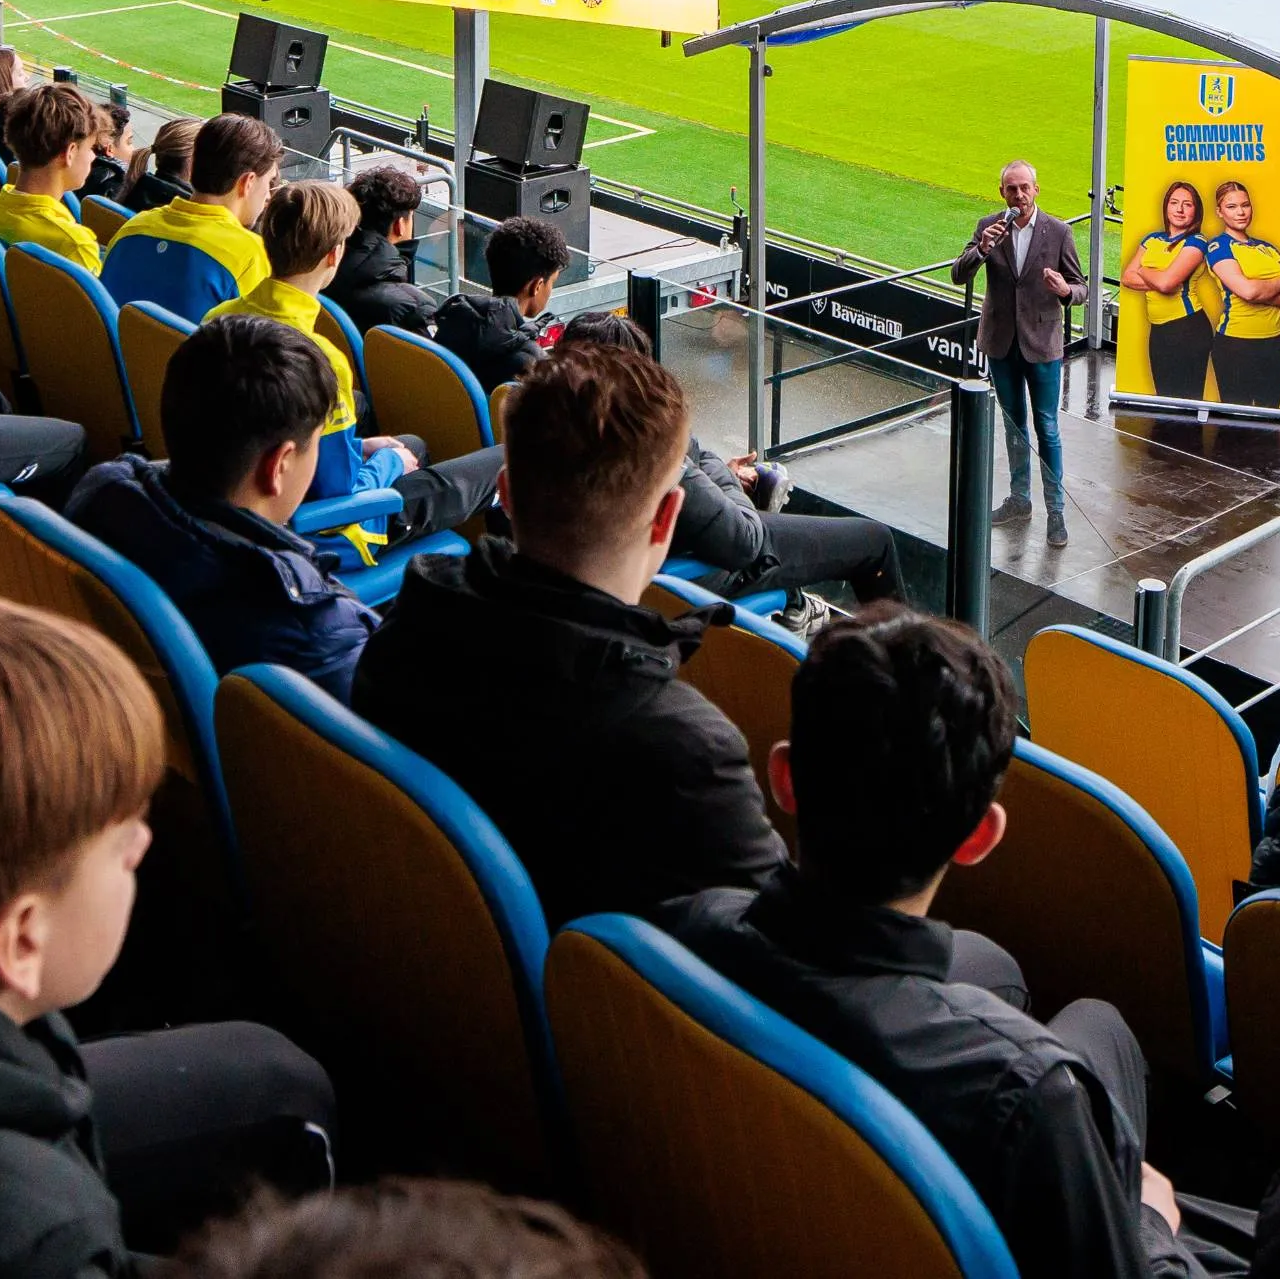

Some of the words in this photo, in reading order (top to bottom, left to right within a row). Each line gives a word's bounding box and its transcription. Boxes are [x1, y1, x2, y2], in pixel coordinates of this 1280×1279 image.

[1164, 124, 1265, 144] COMMUNITY
[1165, 142, 1266, 162] CHAMPIONS
[831, 300, 885, 336] Bavaria
[926, 335, 963, 362] van
